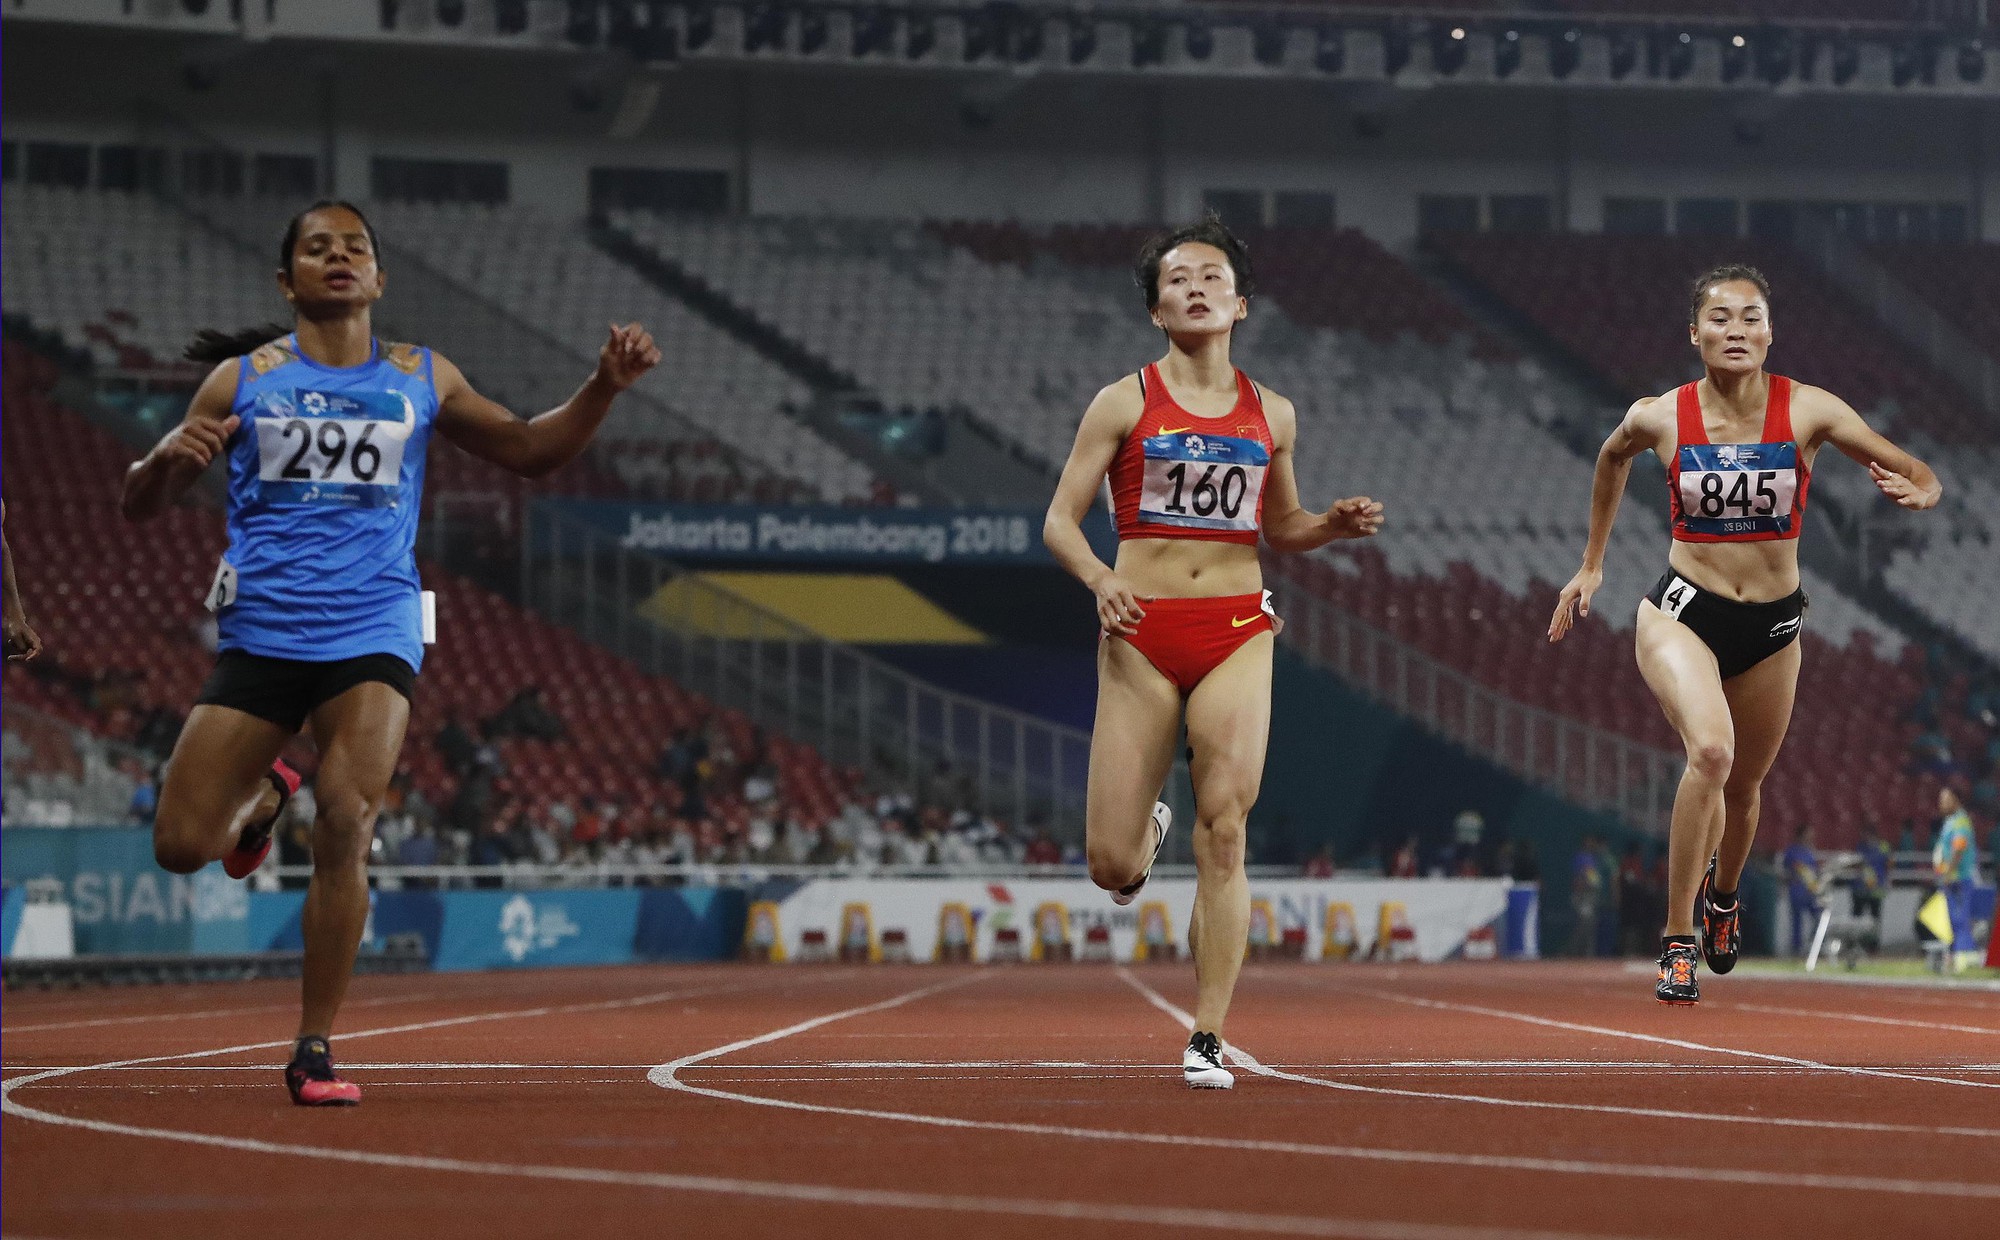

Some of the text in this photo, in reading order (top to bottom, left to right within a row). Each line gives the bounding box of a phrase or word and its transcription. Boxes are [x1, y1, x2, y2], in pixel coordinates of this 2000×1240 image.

[280, 418, 381, 482] 296
[1164, 462, 1247, 519] 160
[1700, 471, 1777, 518] 845
[622, 512, 1030, 562] Jakarta Palembang 2018
[1735, 521, 1756, 531] BNI
[215, 570, 230, 607] 6
[1666, 585, 1688, 611] 4
